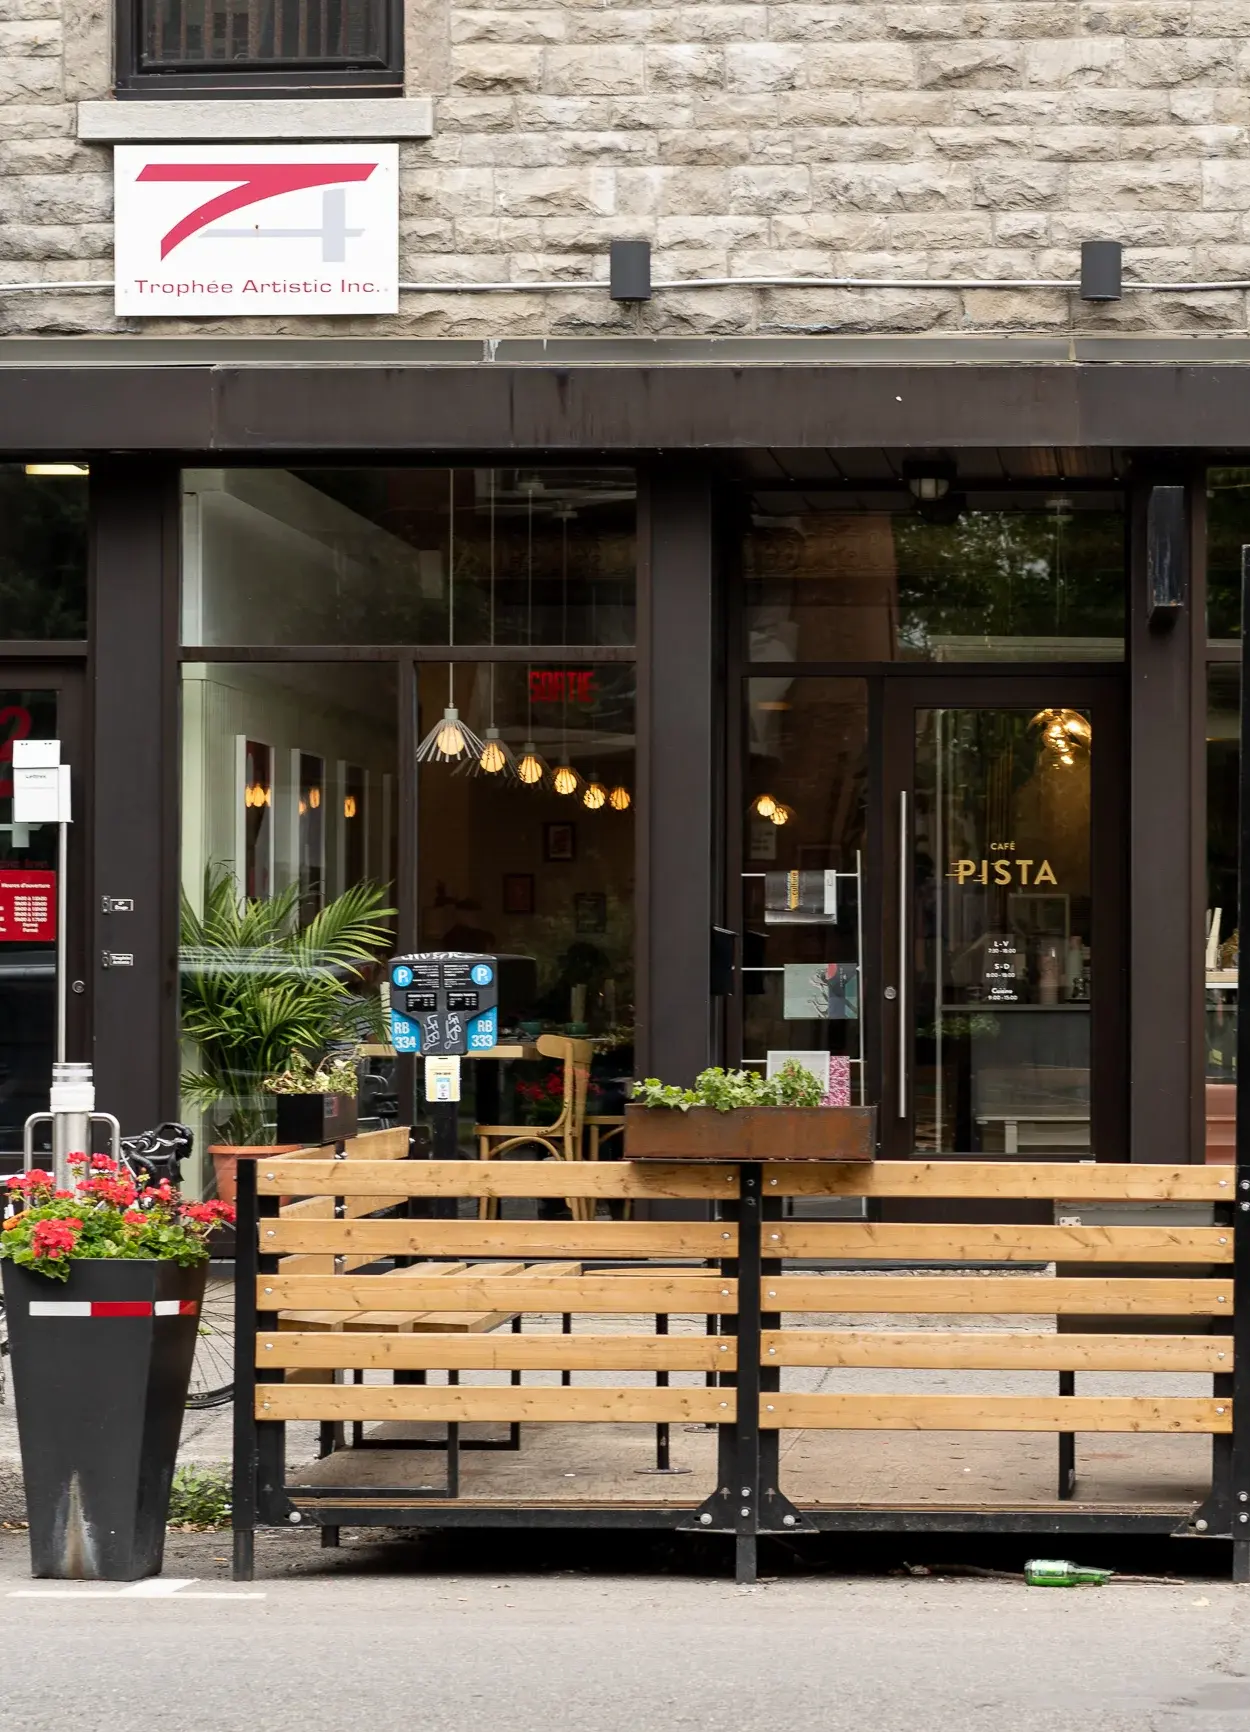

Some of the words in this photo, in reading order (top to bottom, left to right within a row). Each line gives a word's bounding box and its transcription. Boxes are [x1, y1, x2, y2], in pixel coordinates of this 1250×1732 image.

[134, 279, 234, 297] Trophée
[241, 279, 333, 294] Artistic
[340, 279, 381, 294] Inc.
[990, 840, 1016, 851] CAFÉ
[946, 859, 1058, 885] PISTA
[394, 1021, 410, 1034] RB
[477, 1020, 493, 1033] RB
[394, 1036, 417, 1049] 334
[471, 1034, 493, 1048] 333
